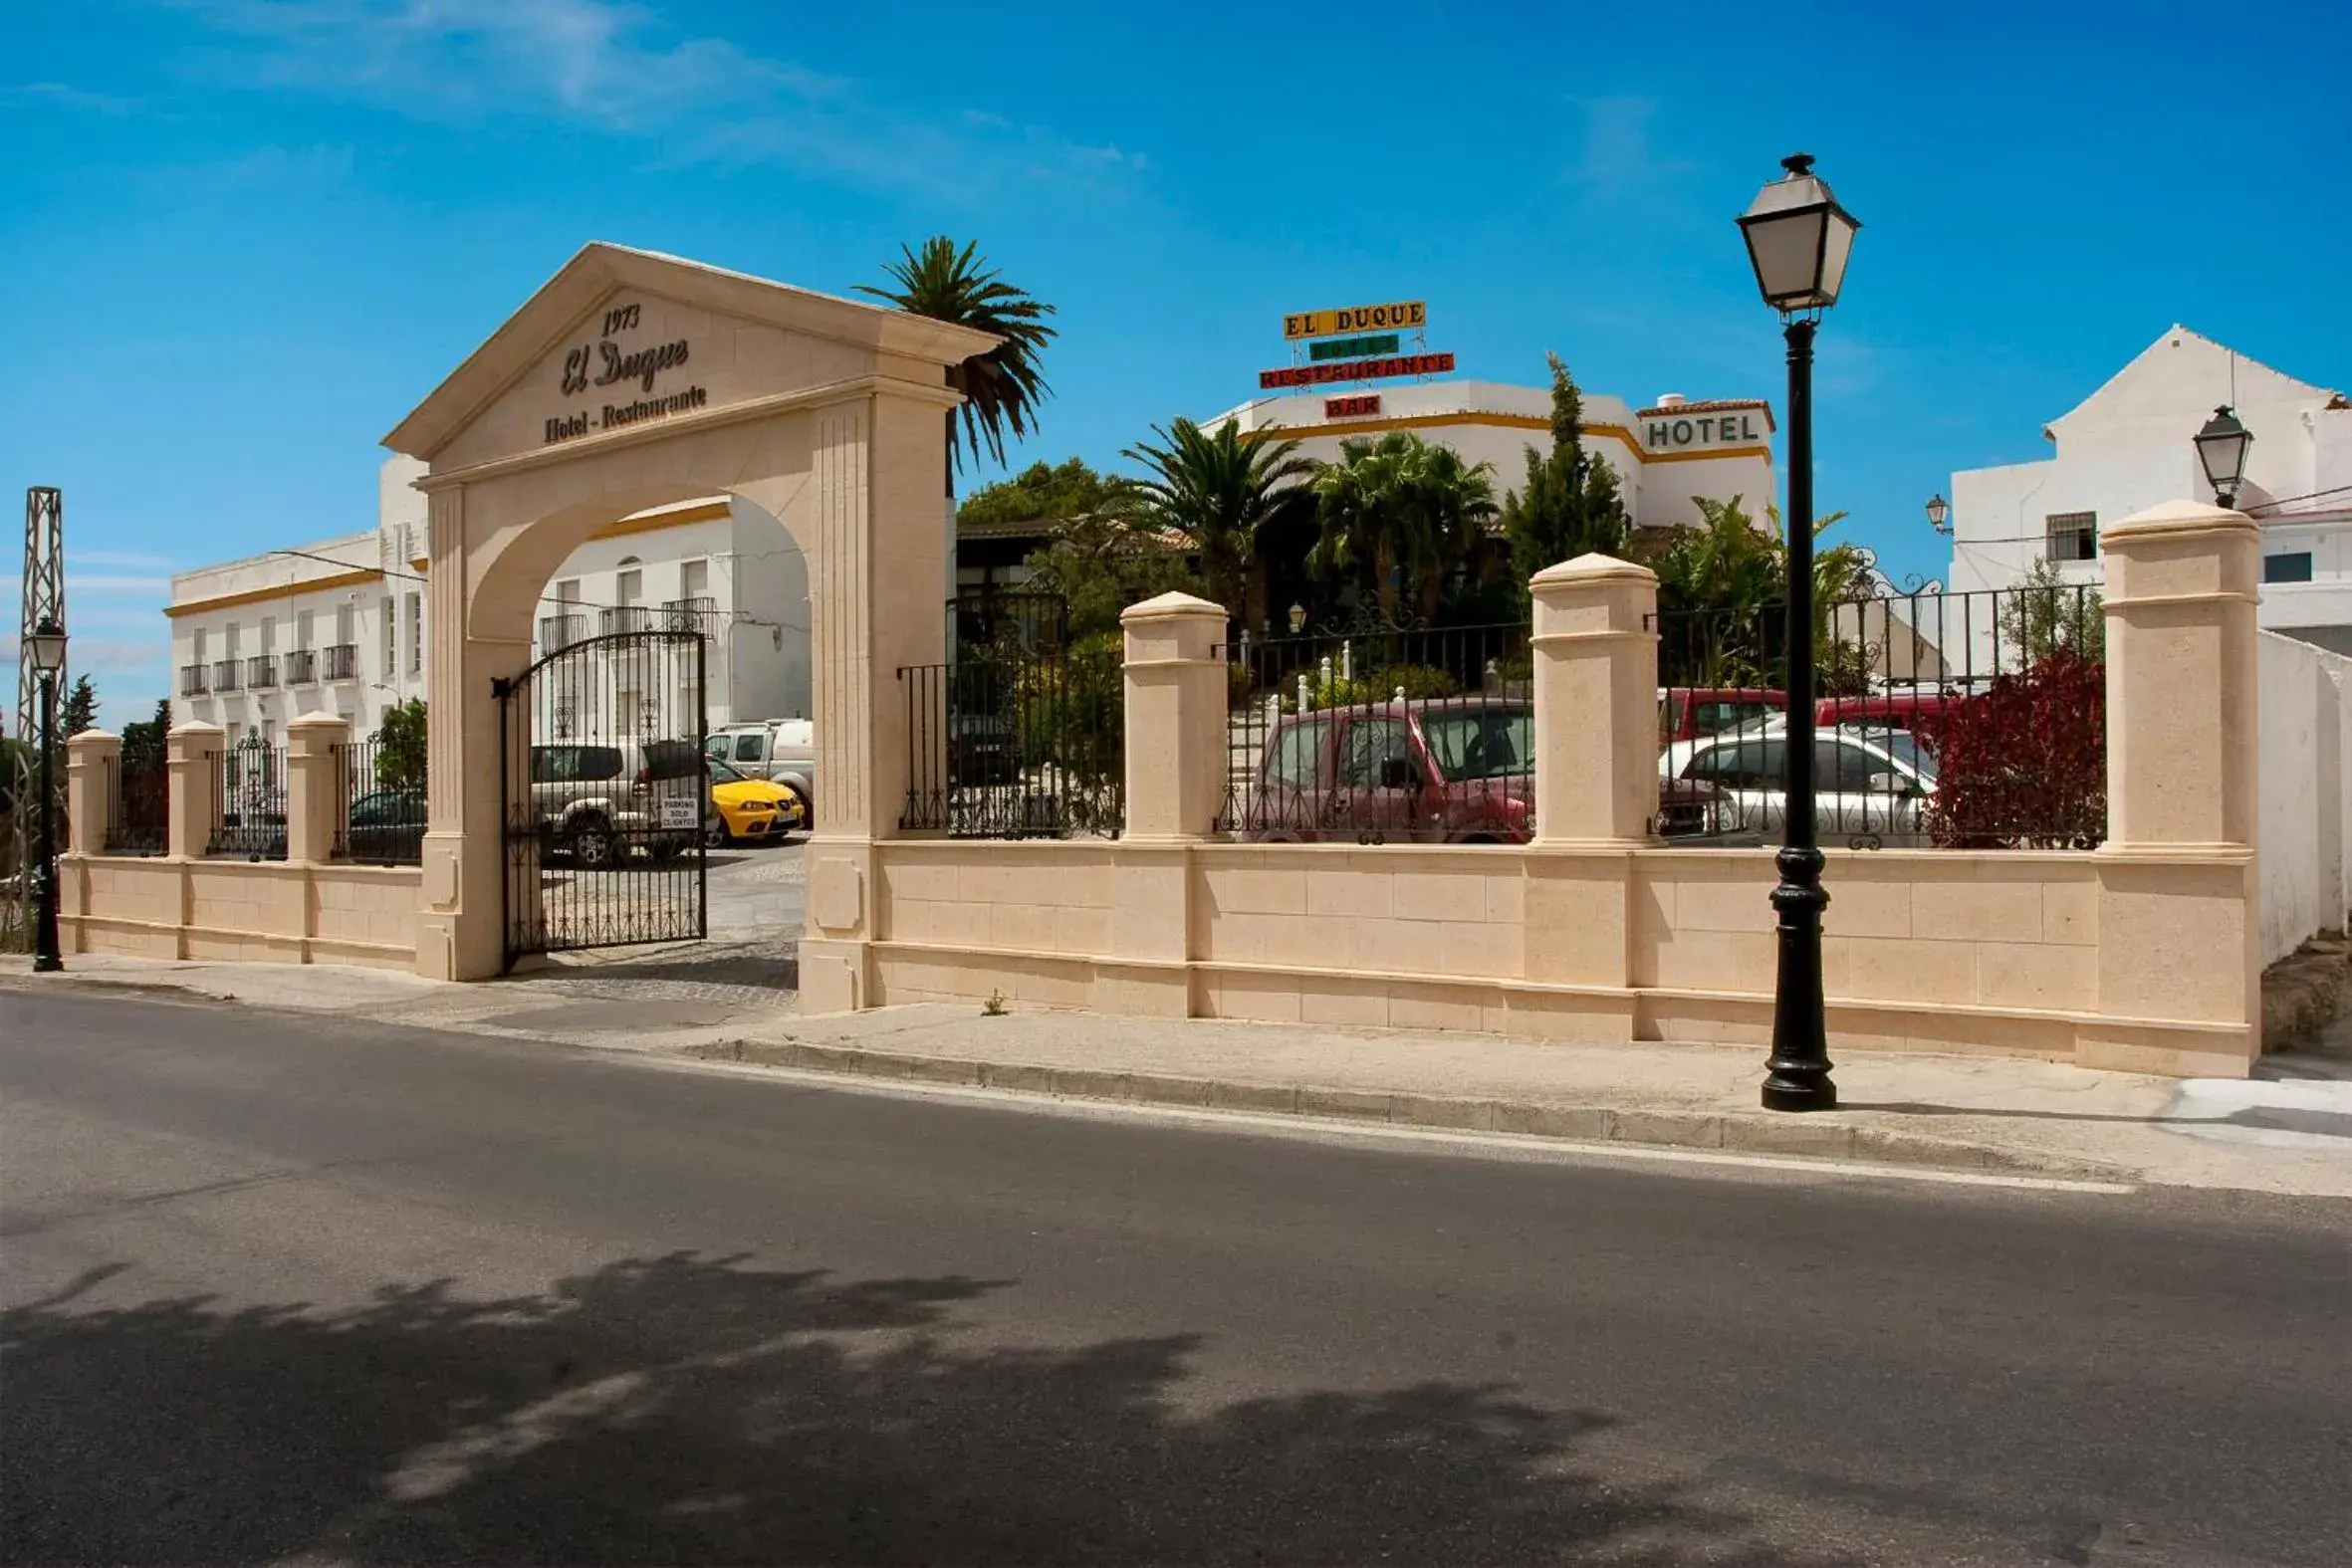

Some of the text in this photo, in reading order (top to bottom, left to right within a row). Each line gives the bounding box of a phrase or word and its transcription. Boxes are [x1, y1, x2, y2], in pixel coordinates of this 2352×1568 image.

[601, 303, 640, 337] 1973
[1286, 303, 1424, 336] EL DUQUE
[561, 338, 689, 396] El Duque
[1260, 353, 1455, 388] RESTAURANTE
[545, 410, 588, 443] Hotel
[601, 385, 707, 428] Restaurante
[1326, 395, 1380, 417] BAR
[1649, 415, 1759, 447] HOTEL
